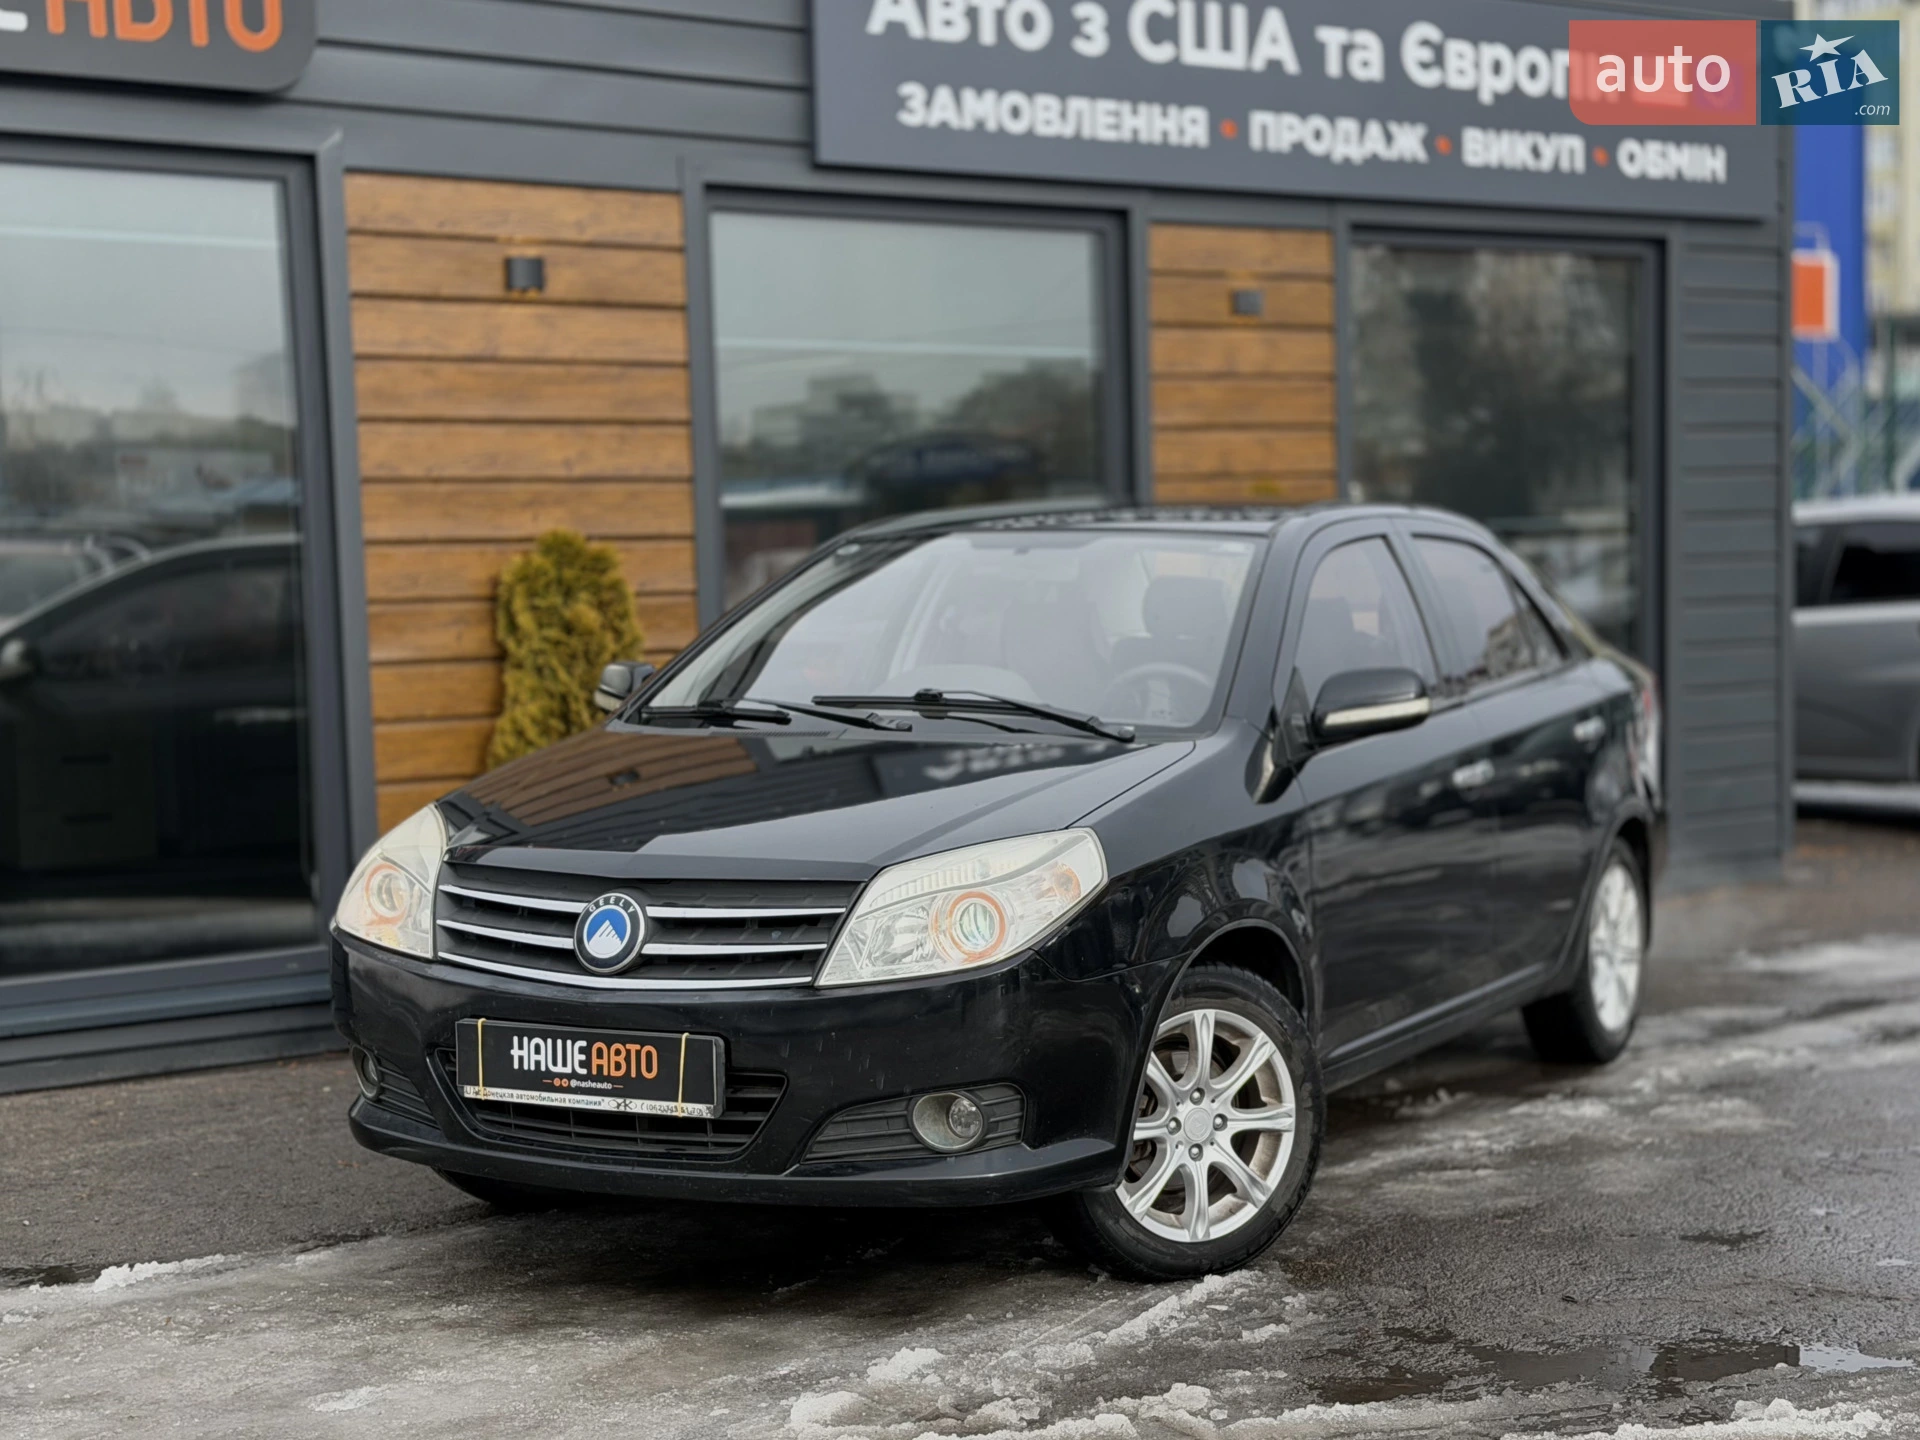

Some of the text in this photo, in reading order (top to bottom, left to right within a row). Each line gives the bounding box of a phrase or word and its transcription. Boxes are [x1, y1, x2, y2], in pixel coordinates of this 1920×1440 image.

[865, 0, 1054, 51] Авто
[1127, 0, 1301, 75] США
[1314, 25, 1385, 82] та
[896, 80, 1728, 183] ЗАМОВЛЕННЯ ПРОДАЖ ВИКУП ОБМІН
[588, 896, 636, 913] GEELY
[510, 1035, 658, 1079] НАШЕ АВТО
[570, 1078, 613, 1090] @nasheauto
